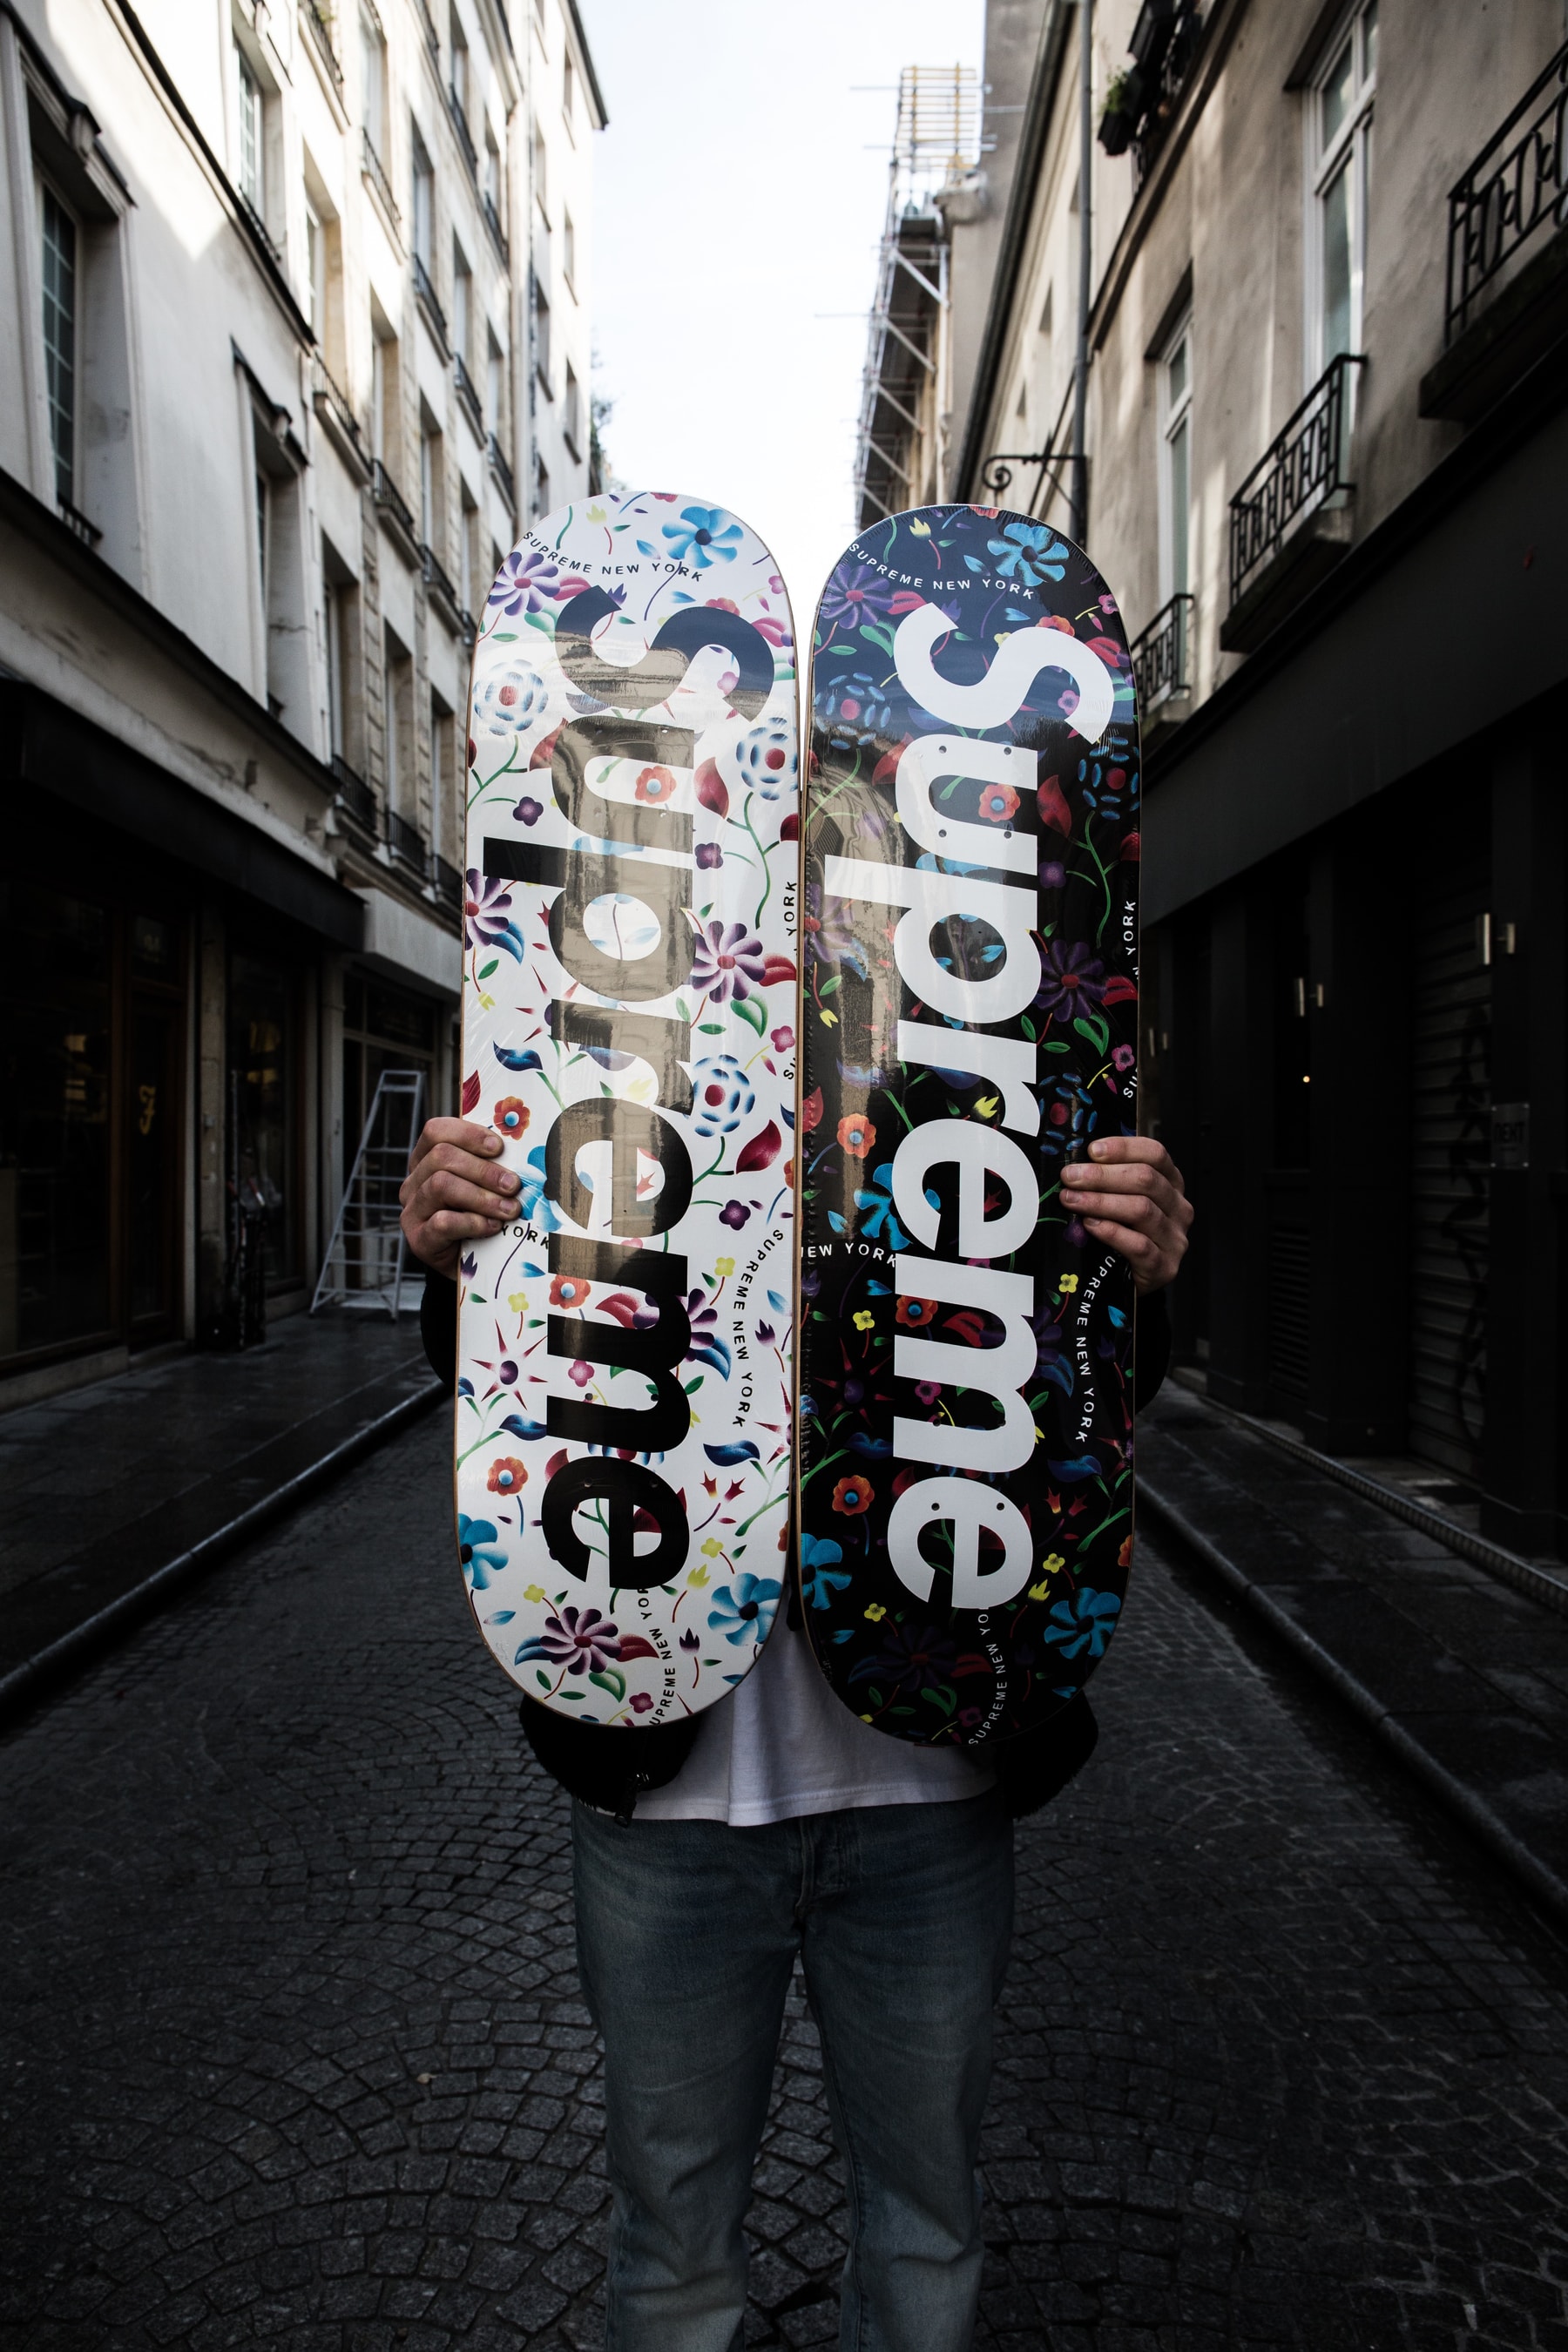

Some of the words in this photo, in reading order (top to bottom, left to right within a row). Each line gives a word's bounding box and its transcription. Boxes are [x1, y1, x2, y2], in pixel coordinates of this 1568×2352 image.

[523, 531, 592, 574] SUPREME
[601, 564, 640, 576] NEW
[652, 562, 703, 583] YORK
[848, 543, 923, 589] SUPREME
[932, 579, 971, 591] NEW
[982, 578, 1035, 600] YORK
[783, 881, 797, 936] YORK
[1122, 900, 1136, 956] YORK
[483, 585, 775, 1590] Supreme
[824, 602, 1115, 1610] Supreme
[501, 1224, 550, 1250] YORK
[801, 1243, 833, 1258] EW
[844, 1242, 896, 1268] YORK
[733, 1229, 784, 1310] SUPREME
[1077, 1255, 1116, 1327] UPREME
[733, 1320, 750, 1360] NEW
[1076, 1336, 1092, 1375] NEW
[732, 1372, 754, 1428] YORK
[1075, 1388, 1095, 1443] YORK
[648, 1627, 672, 1660] NEW
[985, 1643, 1006, 1675] NEW
[648, 1667, 676, 1726] UPREME
[968, 1681, 1008, 1745] SUPREME
